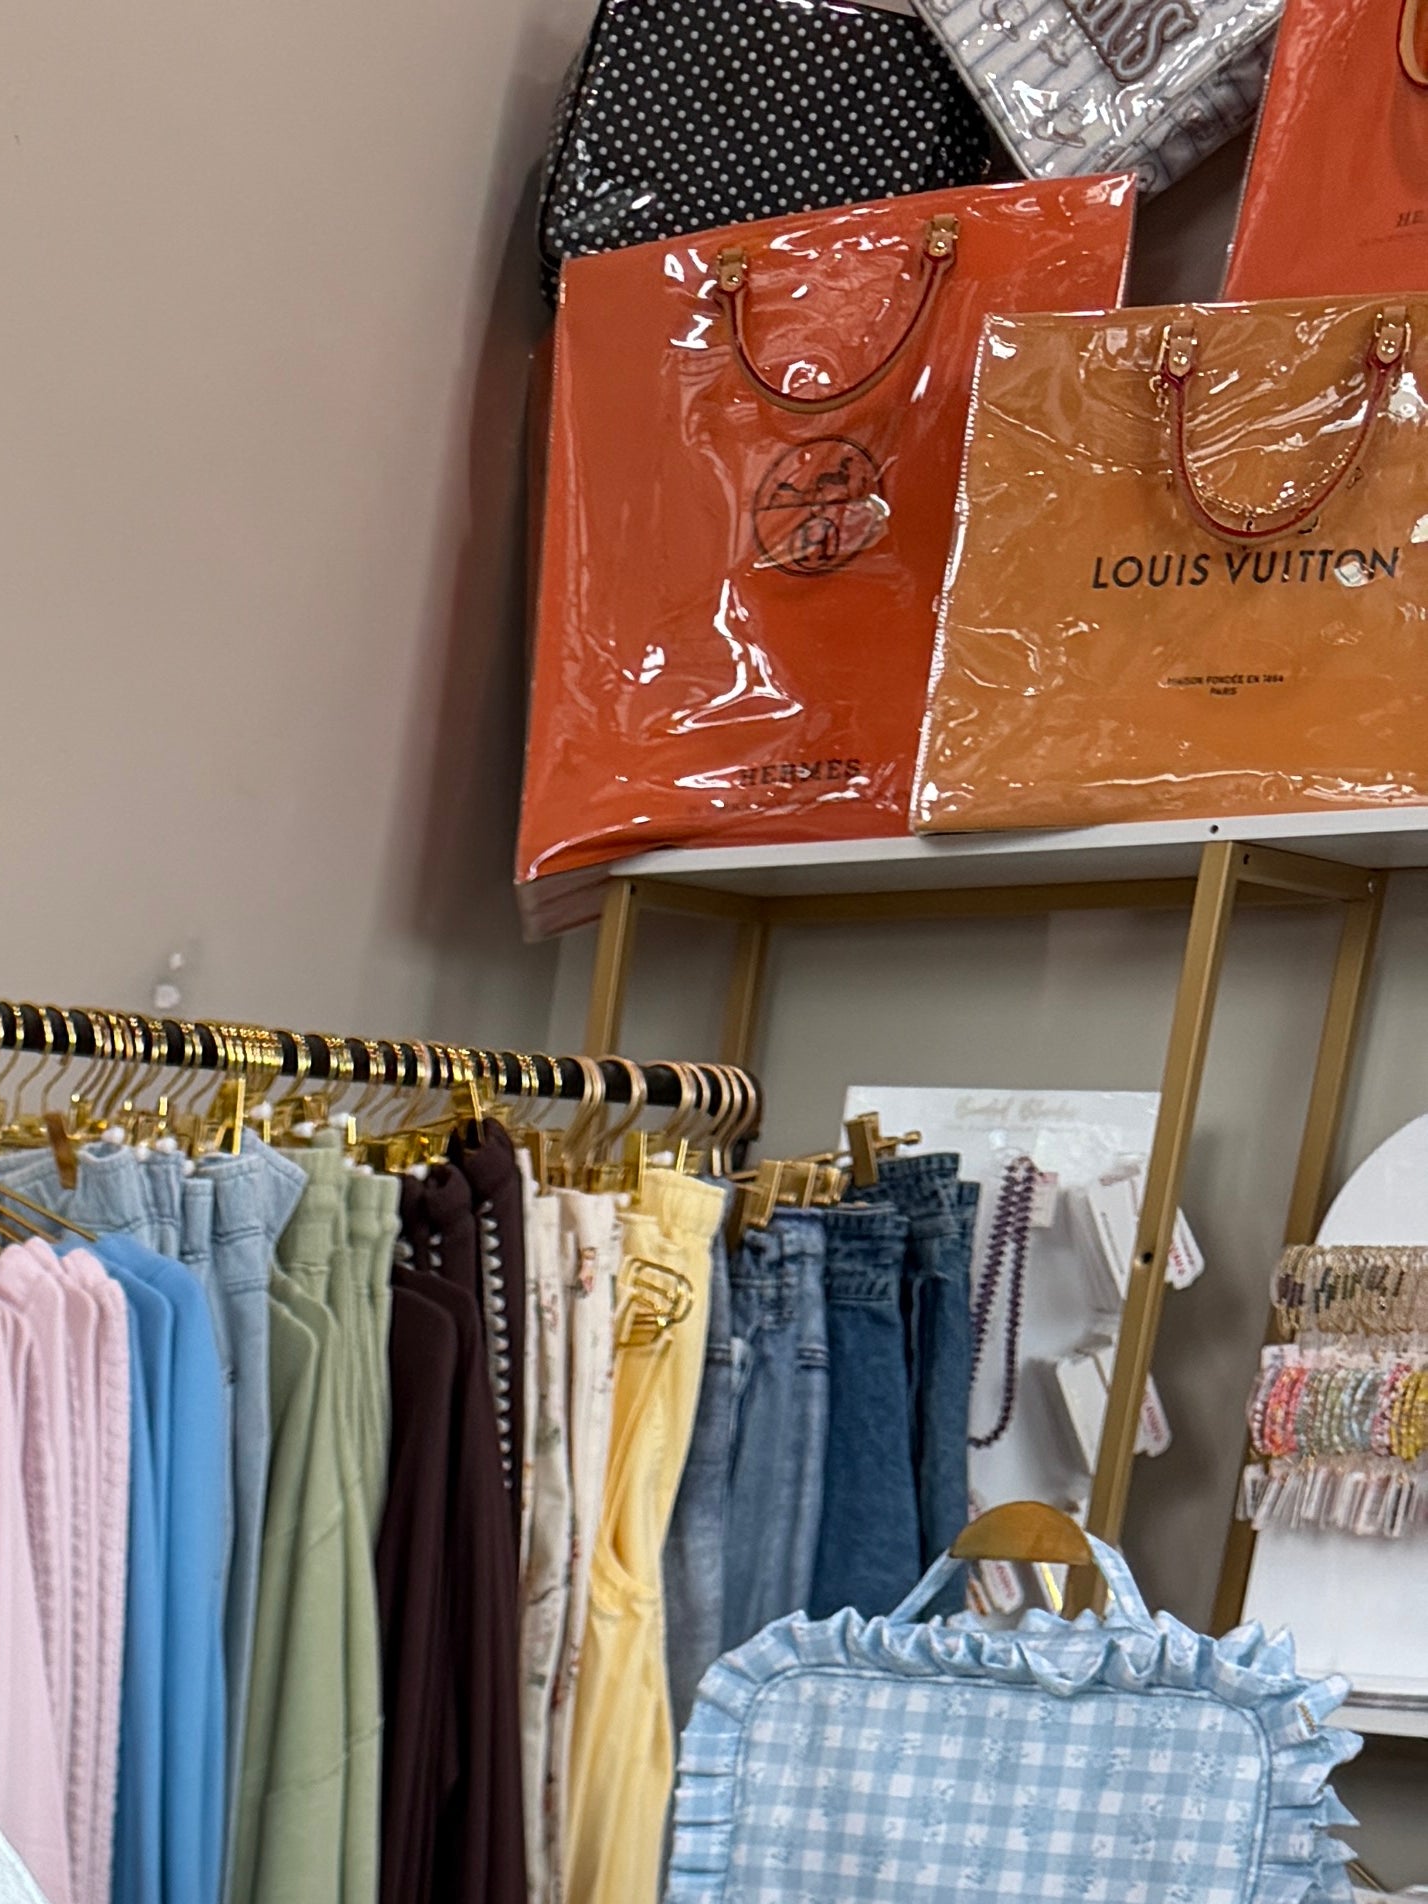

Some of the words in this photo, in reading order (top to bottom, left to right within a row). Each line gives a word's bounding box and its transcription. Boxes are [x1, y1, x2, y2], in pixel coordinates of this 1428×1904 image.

[1091, 553, 1211, 589] LOUIS
[1225, 546, 1400, 586] VUITTON
[1246, 674, 1260, 684] EN
[1210, 686, 1238, 696] PARIS
